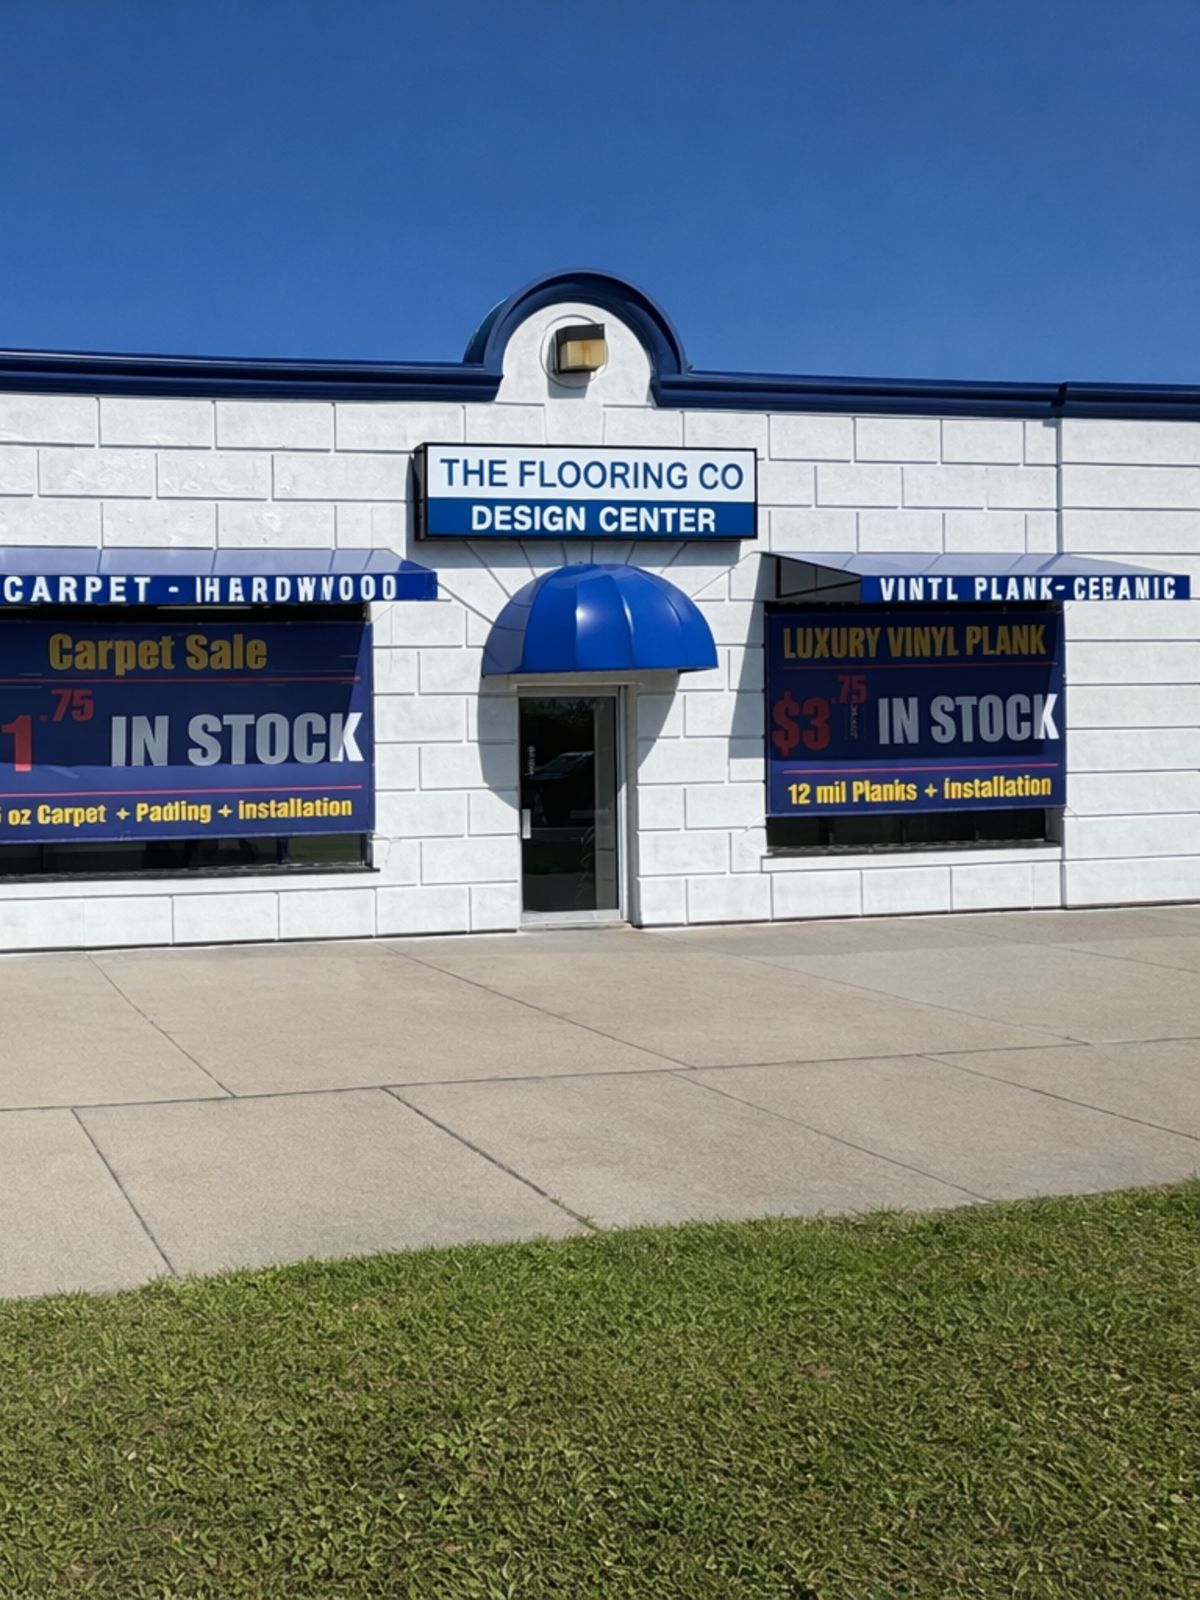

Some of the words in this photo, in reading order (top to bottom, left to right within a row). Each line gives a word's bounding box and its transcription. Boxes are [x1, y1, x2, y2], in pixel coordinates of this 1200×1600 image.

[440, 458, 508, 488] THE
[519, 460, 688, 490] FLOORING
[698, 463, 744, 490] CO
[471, 505, 586, 532] DESIGN
[599, 507, 716, 533] CENTER
[3, 576, 151, 602] CARPET
[48, 633, 175, 676] Carpet
[186, 633, 267, 671] Sale
[783, 627, 881, 659] LUXURY
[887, 626, 959, 657] VINYL
[966, 625, 1047, 656] PLANK
[878, 697, 919, 745] IN
[930, 693, 1060, 743] STOCK
[111, 715, 169, 767] IN
[188, 711, 364, 766] STOCK
[788, 783, 810, 804] 12
[816, 781, 846, 803] mil
[8, 808, 31, 825] oz
[37, 804, 107, 827] Carpet
